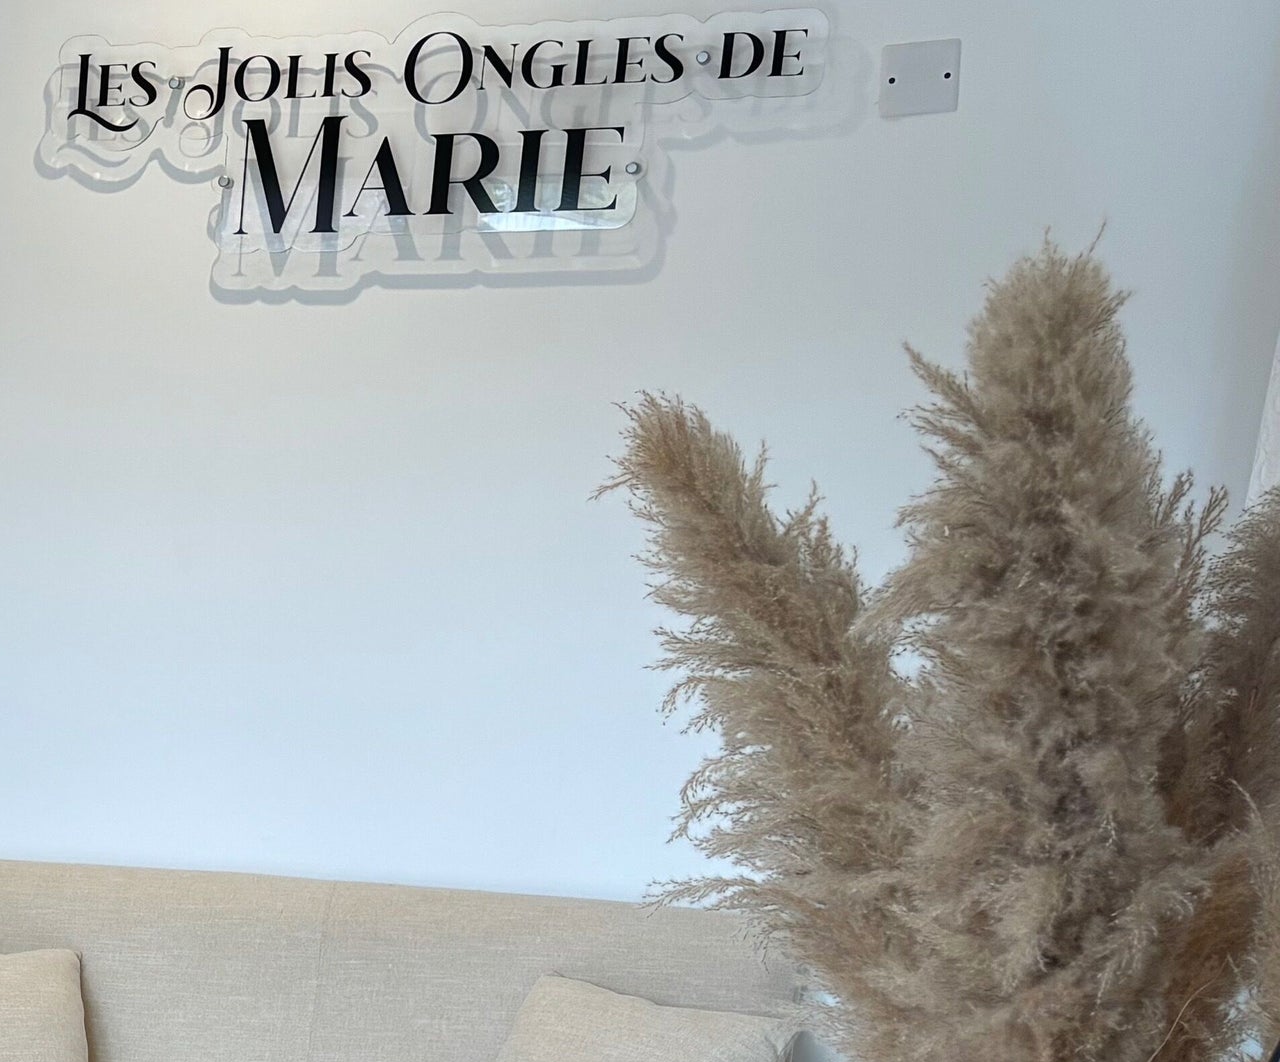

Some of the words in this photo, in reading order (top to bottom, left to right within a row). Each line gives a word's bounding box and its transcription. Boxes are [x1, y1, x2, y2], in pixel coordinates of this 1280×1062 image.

[67, 53, 158, 132] LES
[183, 46, 372, 120] JOLIS
[403, 31, 685, 105] ONGLES
[717, 28, 809, 80] DE
[233, 115, 626, 236] MARIE
